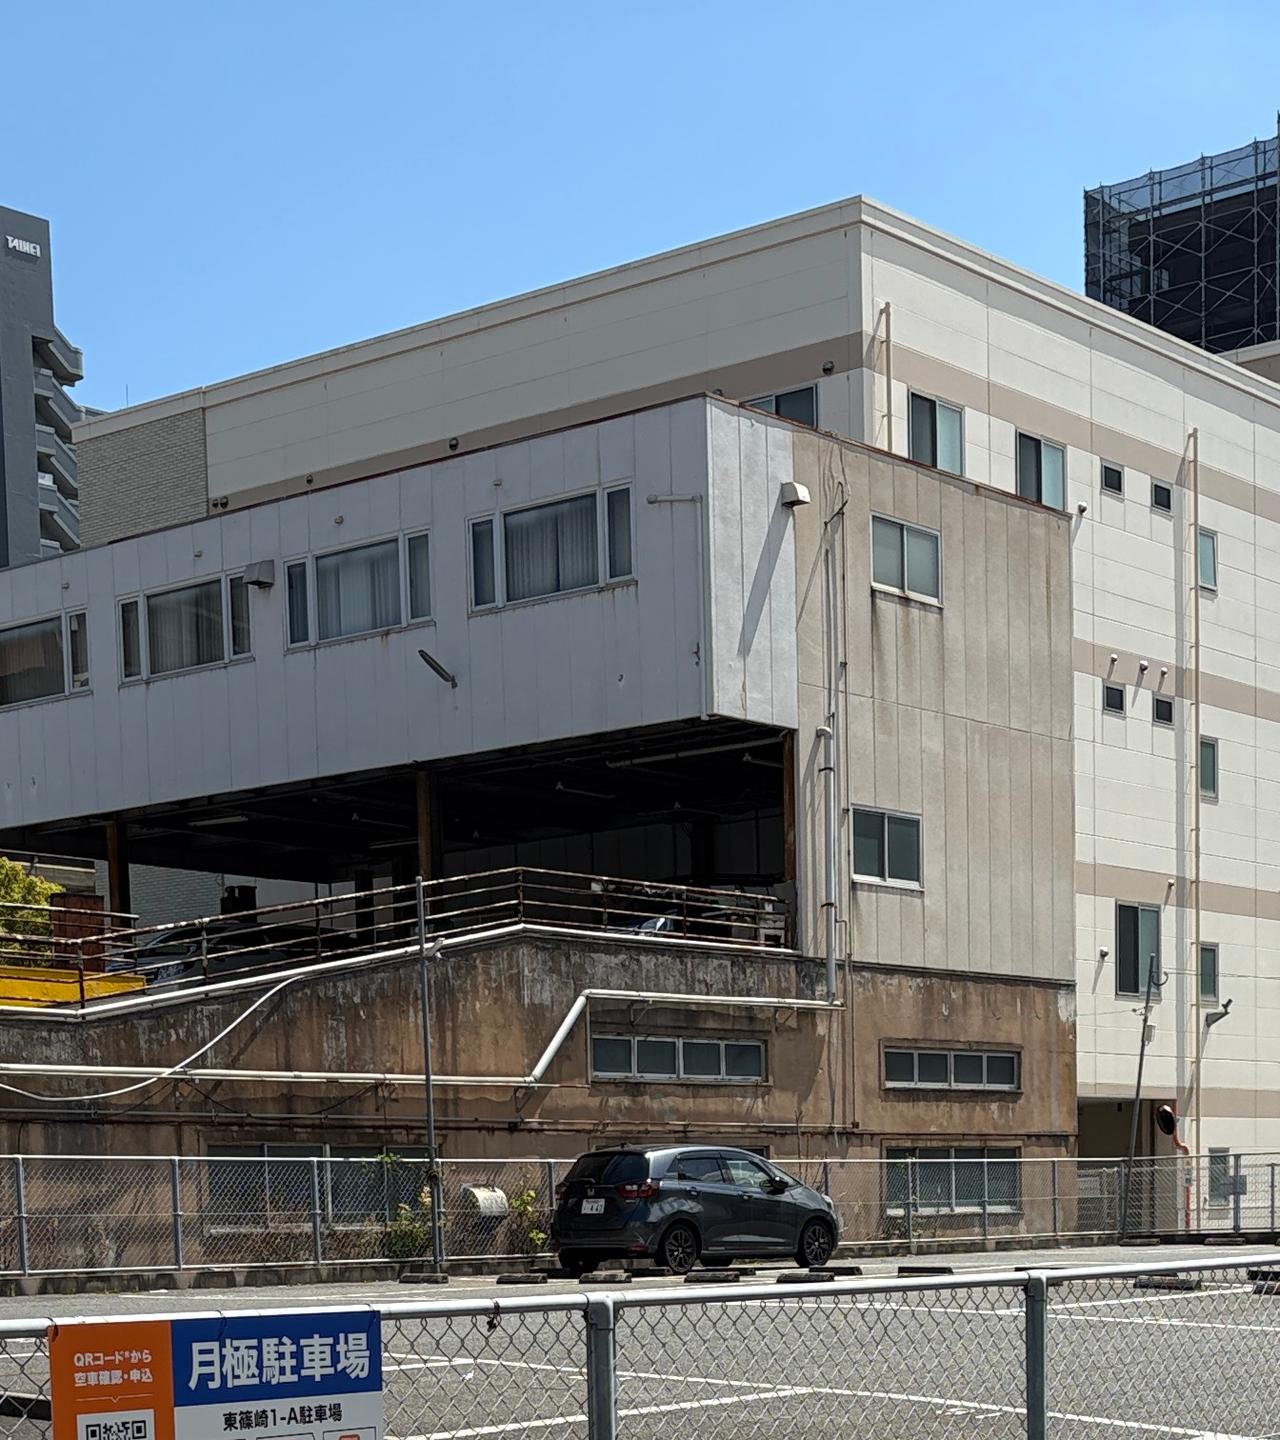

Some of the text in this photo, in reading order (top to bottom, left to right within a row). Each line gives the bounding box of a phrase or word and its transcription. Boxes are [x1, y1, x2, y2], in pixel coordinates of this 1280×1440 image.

[188, 1333, 371, 1391] 月極駐車場
[74, 1367, 153, 1387] 空車確認・申込
[222, 1404, 343, 1431] 東篠崎1-A駐車場
